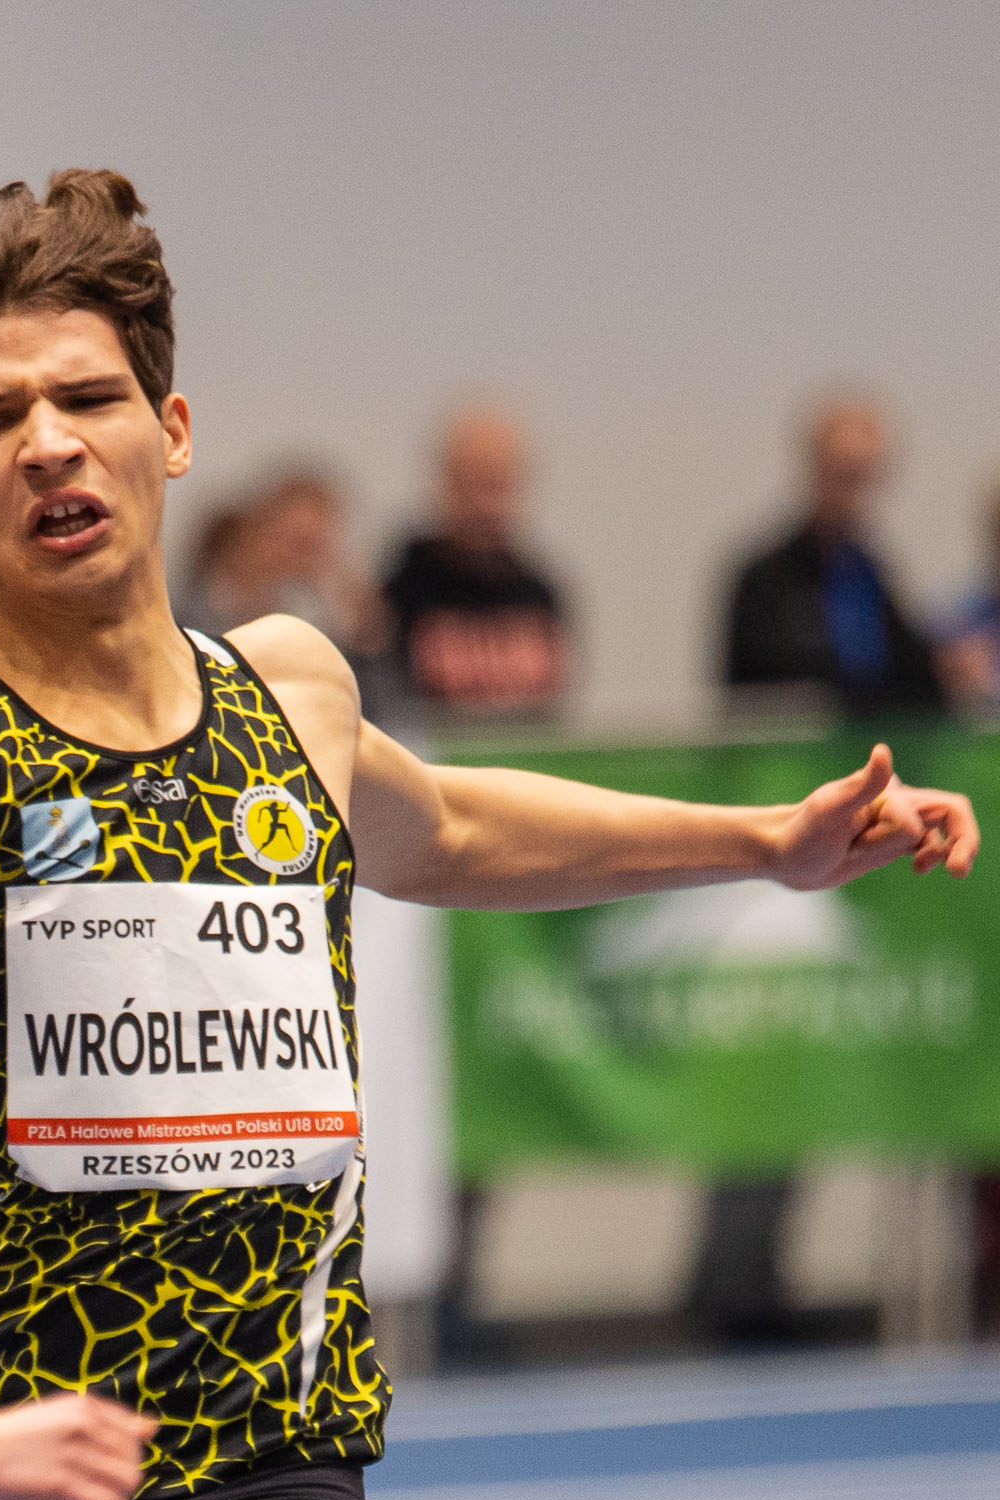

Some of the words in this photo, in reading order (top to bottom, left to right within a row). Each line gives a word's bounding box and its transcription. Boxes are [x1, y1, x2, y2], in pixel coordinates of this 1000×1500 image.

[23, 920, 75, 940] TVP
[82, 918, 156, 939] SPORT
[197, 901, 304, 955] 403
[24, 998, 338, 1076] WRÓBLEWSKI
[27, 1125, 66, 1139] PZLA
[70, 1125, 134, 1139] Halowe
[137, 1122, 232, 1139] Mistrzostwa
[236, 1118, 282, 1134] Polski
[285, 1117, 311, 1132] U18
[315, 1117, 344, 1131] U20
[83, 1148, 221, 1175] RZESZÓW
[230, 1149, 295, 1170] 2023
